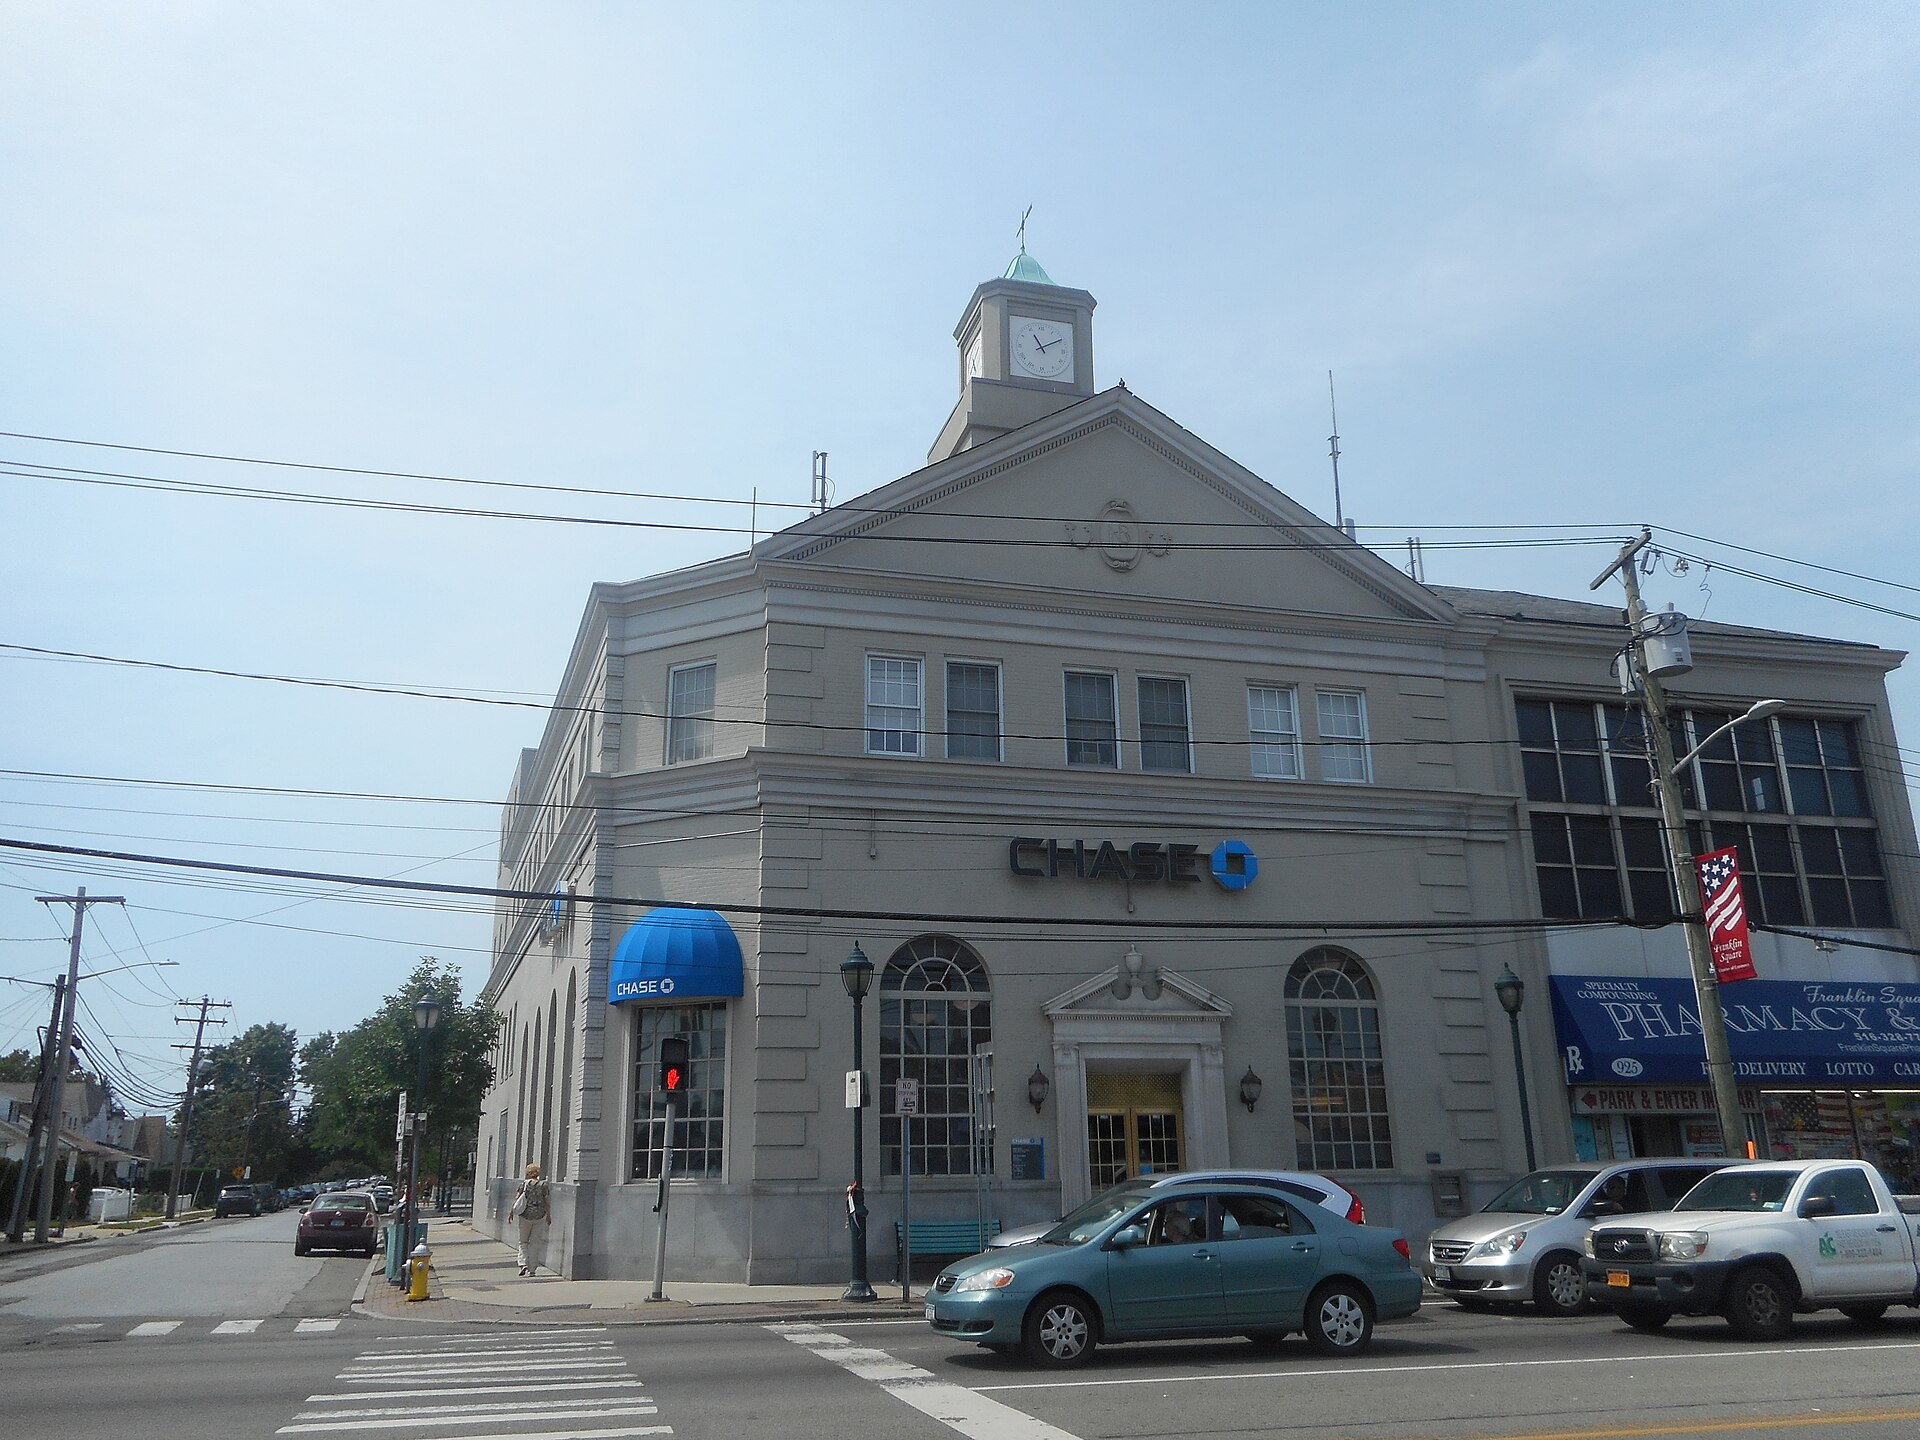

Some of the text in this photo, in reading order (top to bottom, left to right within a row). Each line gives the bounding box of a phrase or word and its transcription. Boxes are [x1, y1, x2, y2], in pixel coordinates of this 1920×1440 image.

[1009, 837, 1201, 882] CHASE
[1713, 938, 1743, 953] Franklin
[1719, 950, 1742, 964] Square
[617, 980, 658, 996] CHASE
[1584, 981, 1640, 992] SPECIALTY
[1577, 990, 1658, 1001] COMPOUNDING
[1803, 985, 1876, 1004] Franklin
[1616, 1060, 1639, 1075] 925
[1738, 1062, 1806, 1076] DELIVERY
[1826, 1062, 1875, 1076] LOTTO
[902, 1082, 912, 1090] NO
[1599, 1089, 1636, 1110] PARK
[1654, 1088, 1700, 1110] ENTER
